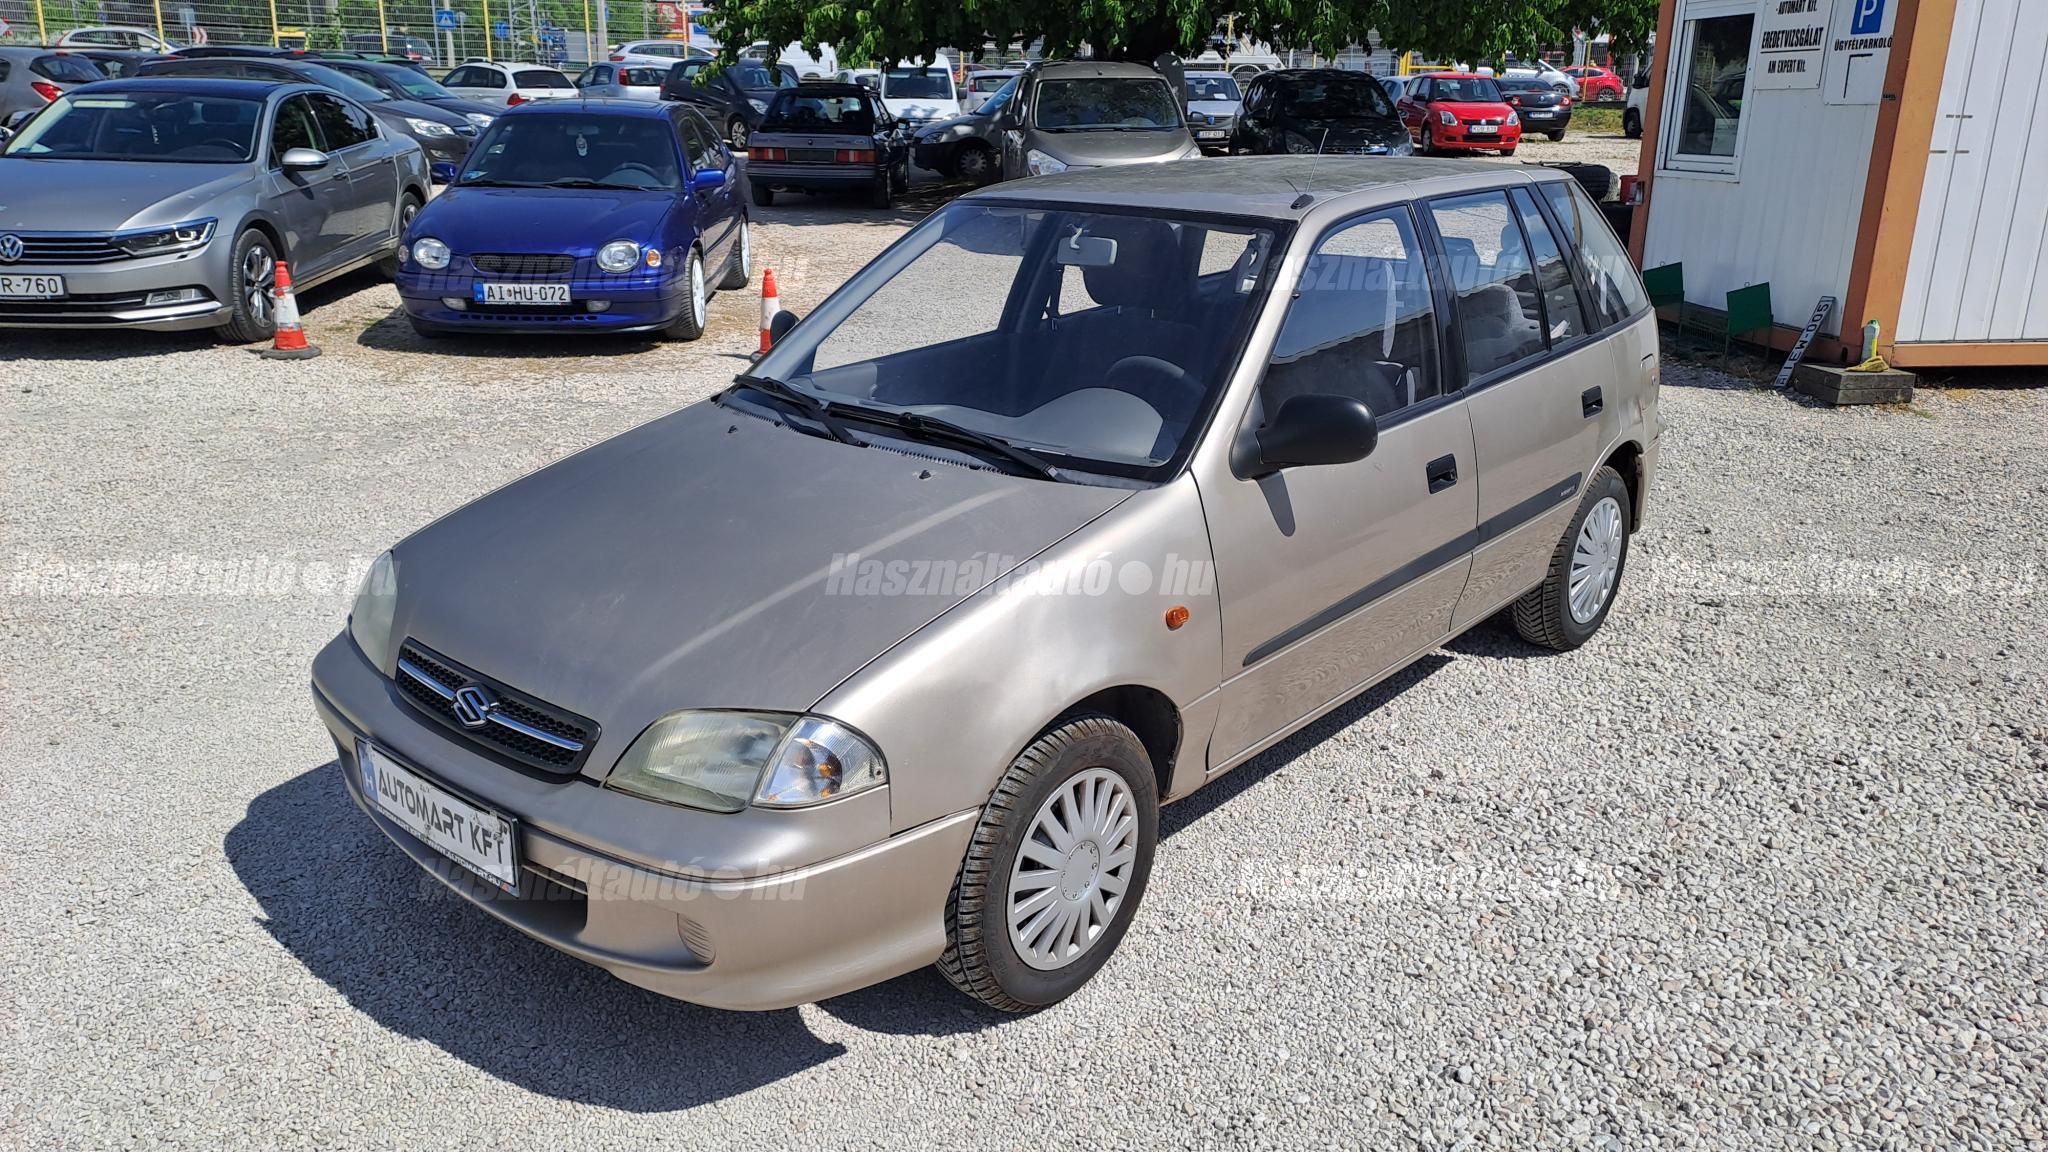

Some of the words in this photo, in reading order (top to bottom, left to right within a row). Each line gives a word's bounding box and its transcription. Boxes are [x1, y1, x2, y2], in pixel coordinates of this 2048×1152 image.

[1762, 24, 1824, 49] EREDETVIZSGÁLAT
[1777, 59, 1796, 73] EXPERT
[1, 277, 59, 294] R-760
[512, 286, 567, 301] HU-072
[378, 767, 464, 844] AUTOMART
[470, 820, 504, 864] KFT
